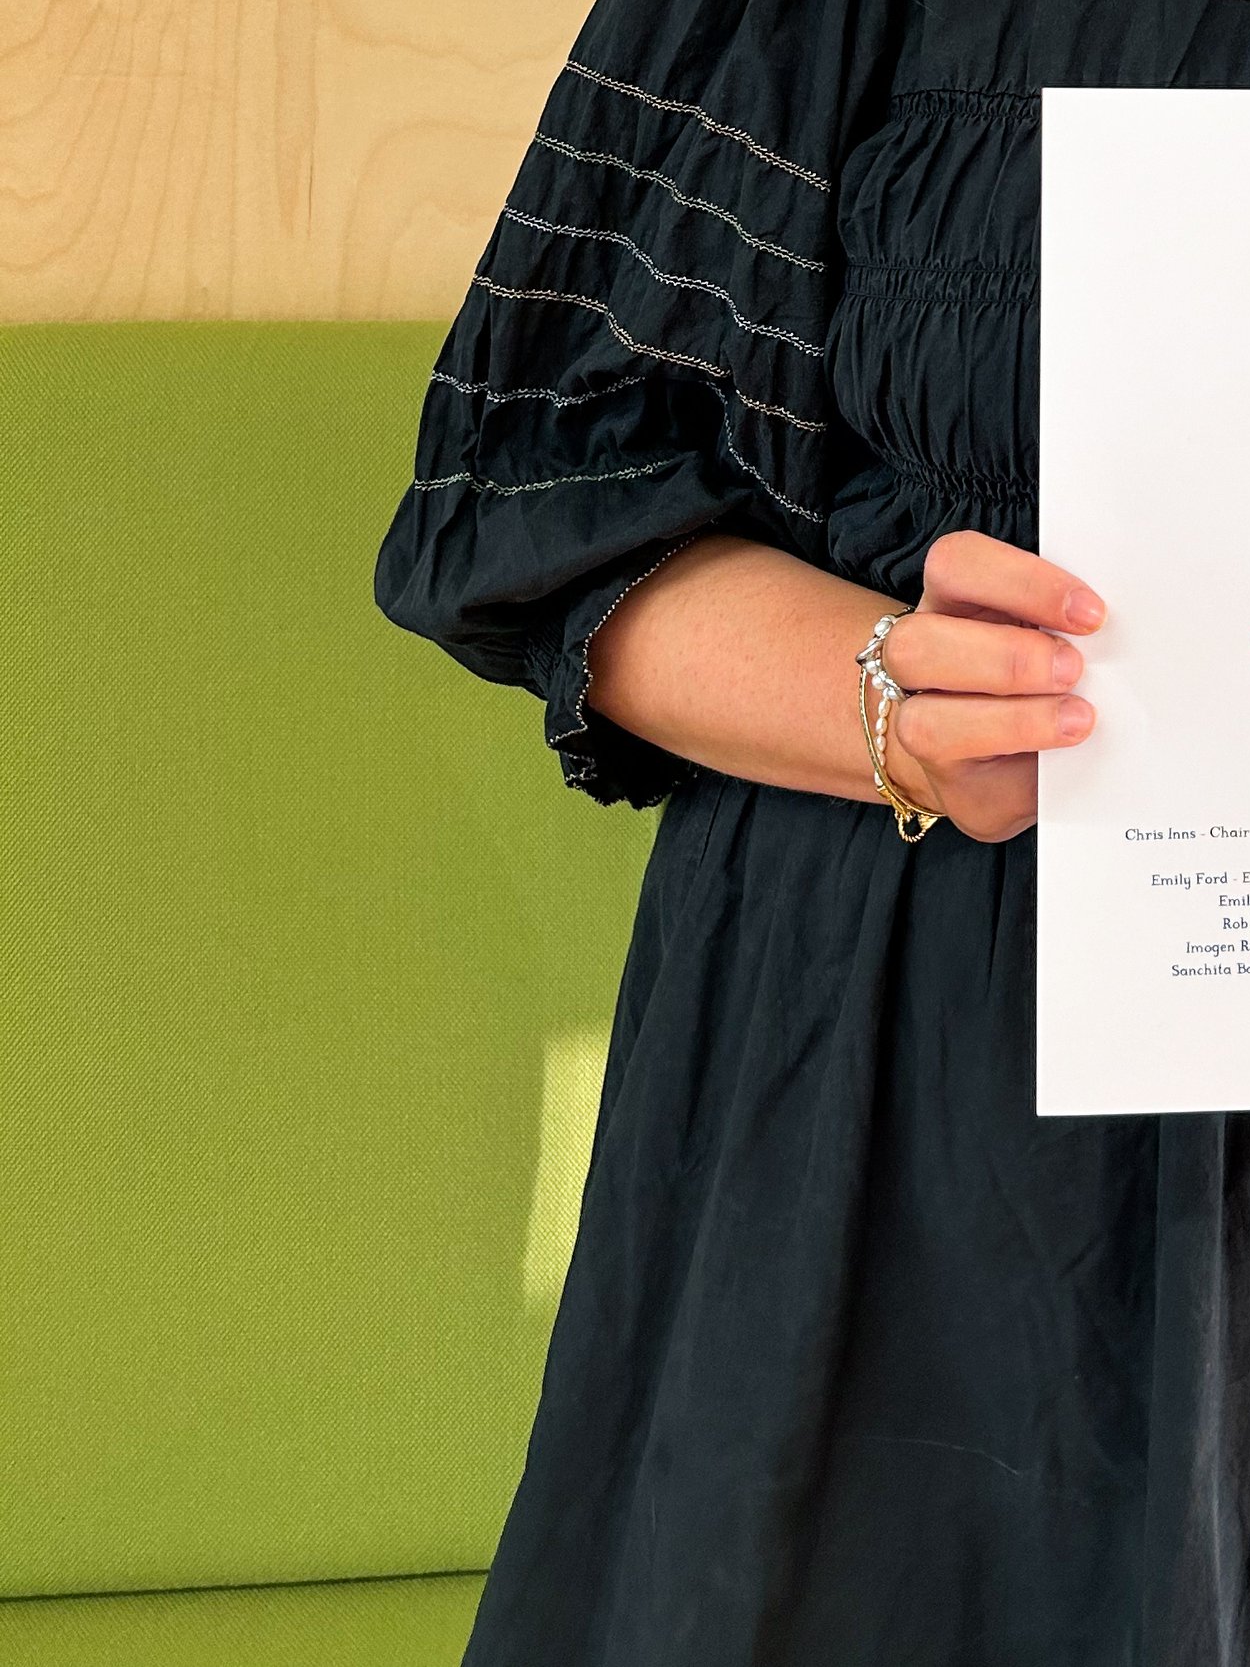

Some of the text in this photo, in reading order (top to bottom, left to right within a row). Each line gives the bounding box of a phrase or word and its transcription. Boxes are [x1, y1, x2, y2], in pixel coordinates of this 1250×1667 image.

[1125, 828, 1164, 841] Chris
[1168, 828, 1196, 840] Inns
[1210, 826, 1250, 838] Chair
[1151, 874, 1191, 890] Emily
[1196, 872, 1228, 884] Ford
[1222, 918, 1248, 930] Rob
[1186, 941, 1236, 956] Imogen
[1172, 964, 1232, 977] Sanchita
